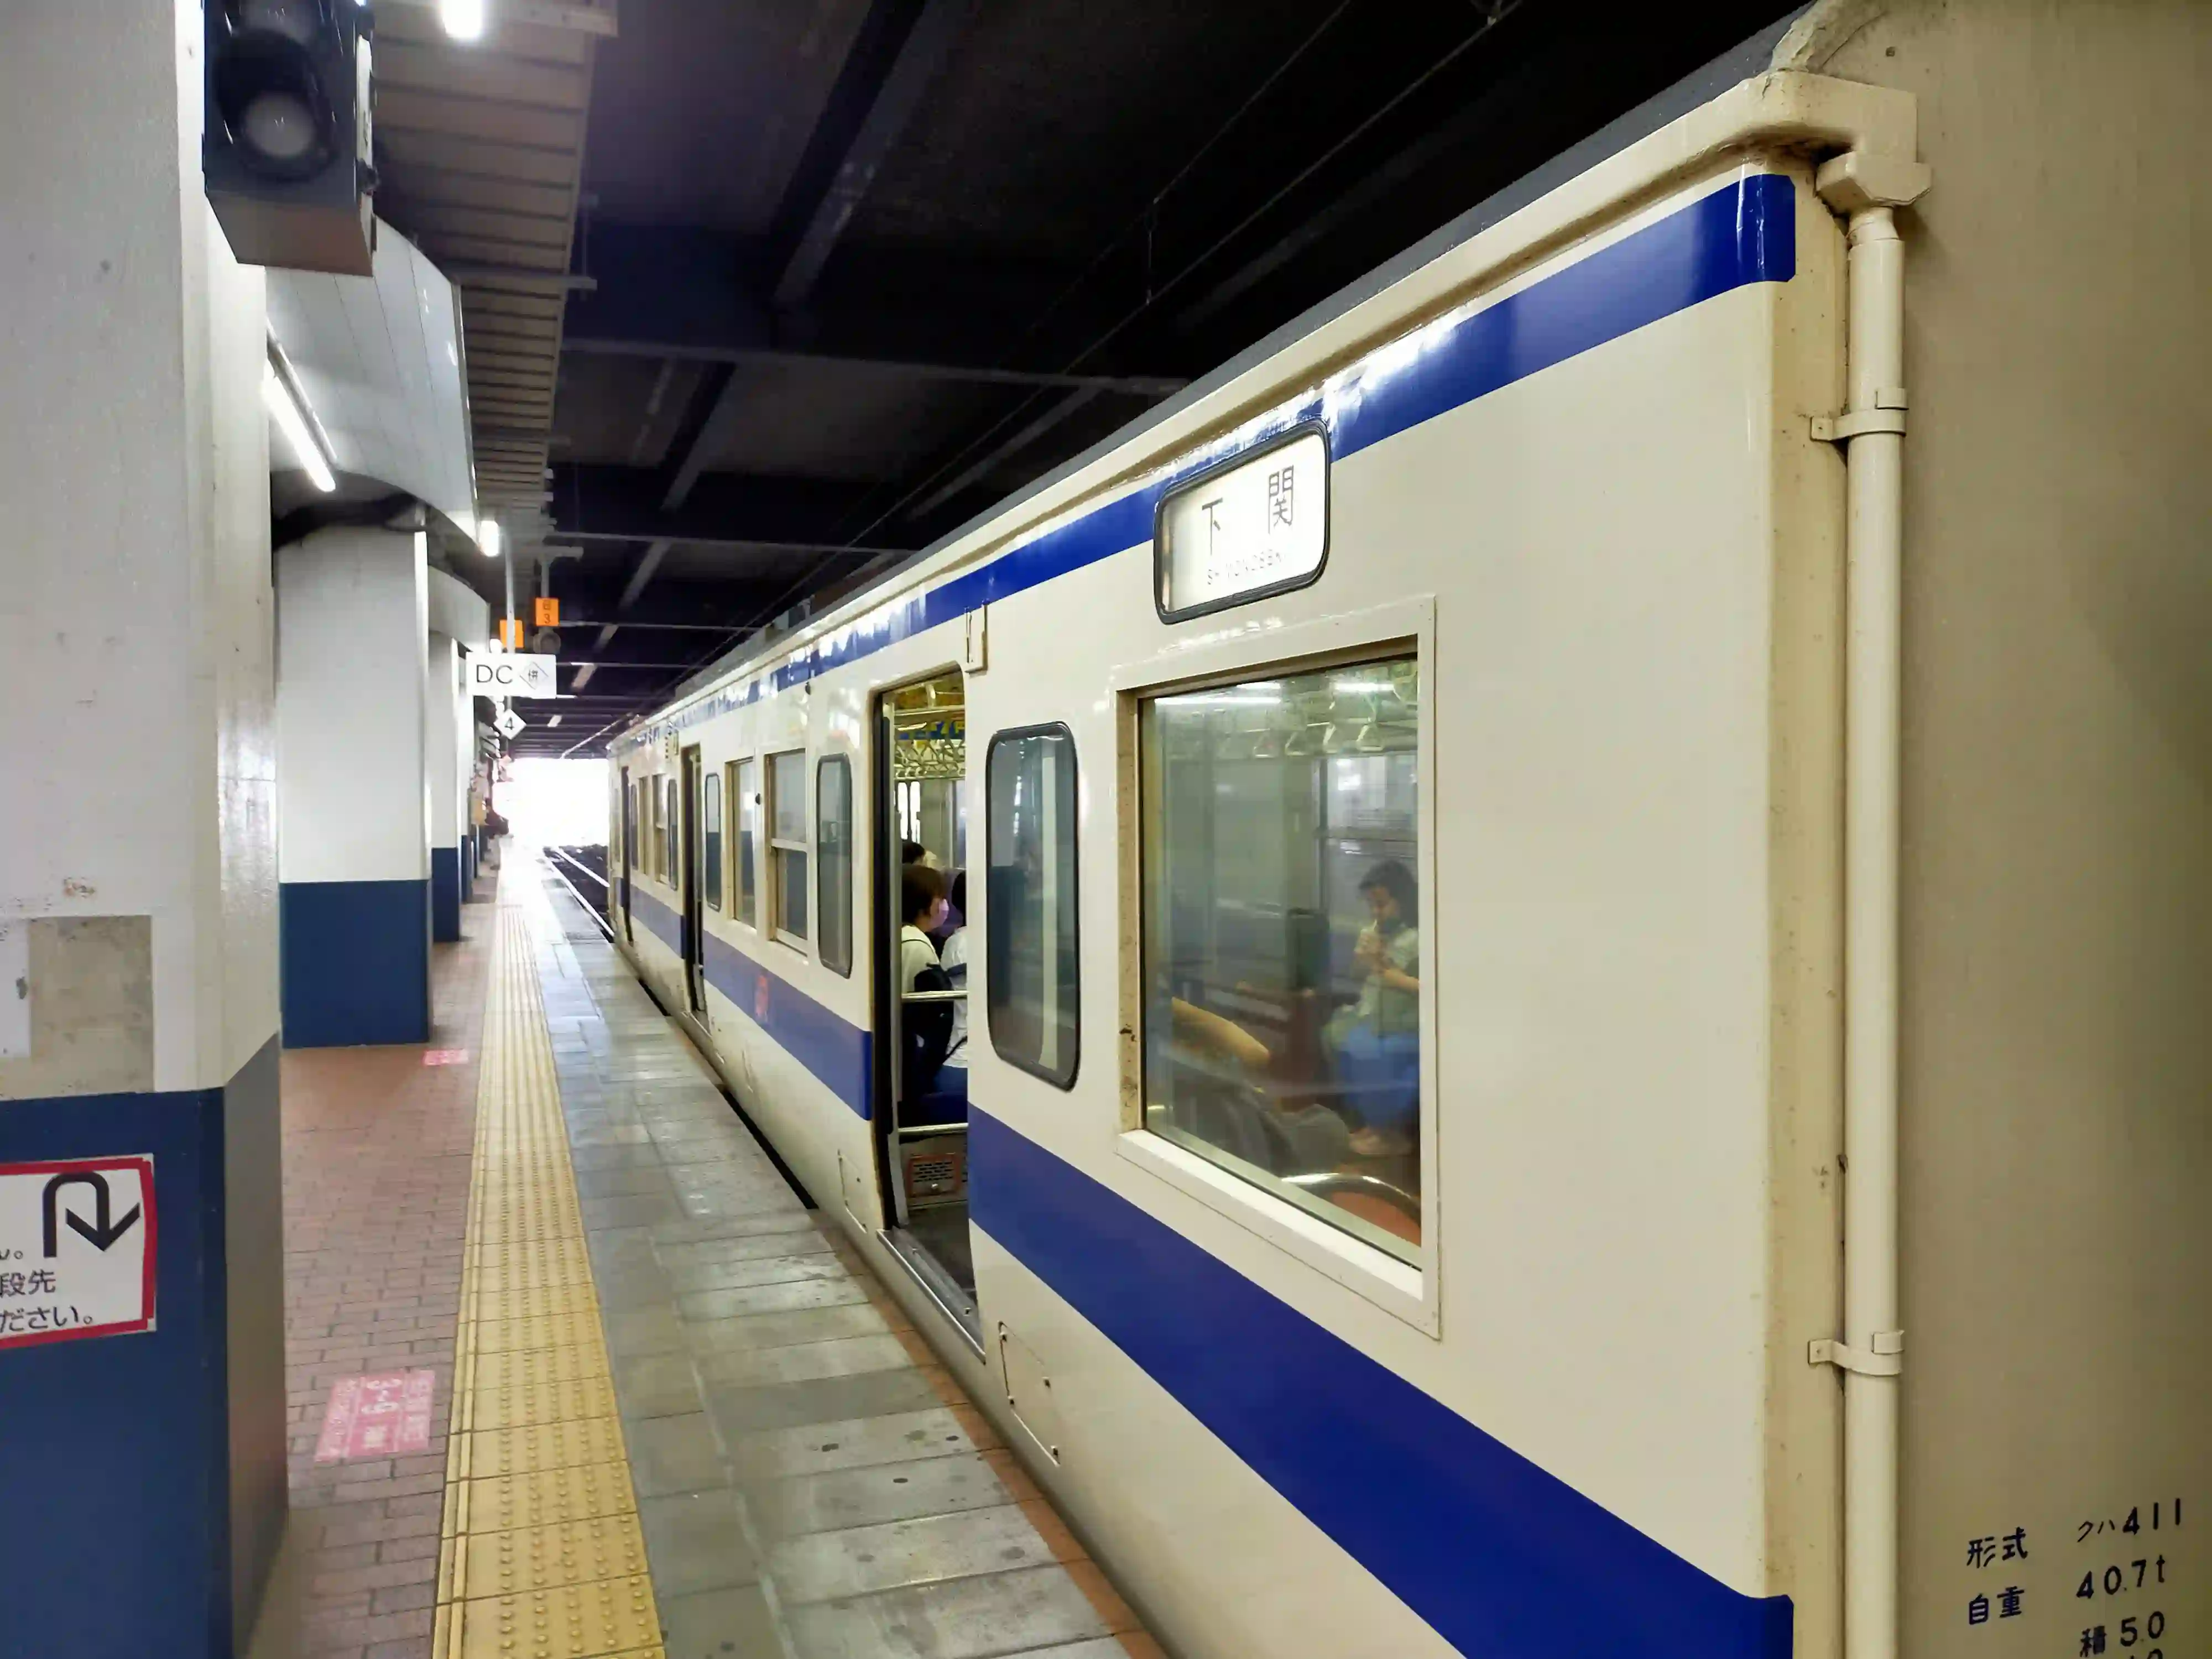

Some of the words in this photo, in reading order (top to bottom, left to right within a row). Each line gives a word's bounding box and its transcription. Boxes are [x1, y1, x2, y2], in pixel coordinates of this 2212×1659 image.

[1201, 465, 1294, 556] 下関
[476, 664, 513, 684] DC
[504, 716, 514, 731] 4
[1966, 1527, 2028, 1568] 形式
[2077, 1498, 2181, 1542] クハ411
[1969, 1585, 2025, 1625] 自重
